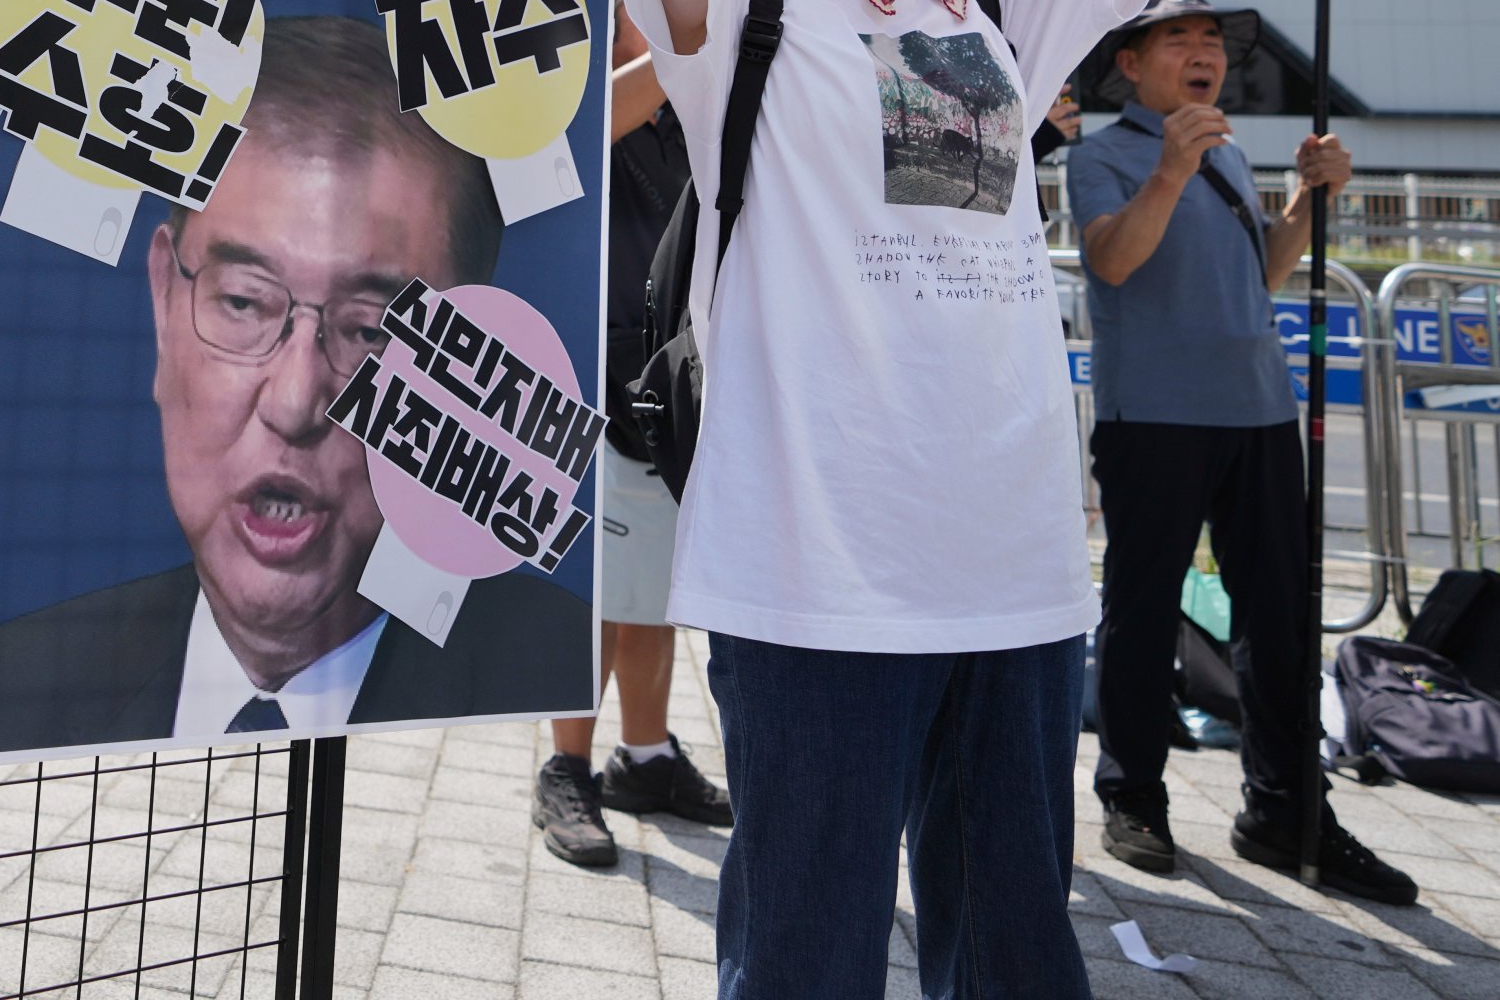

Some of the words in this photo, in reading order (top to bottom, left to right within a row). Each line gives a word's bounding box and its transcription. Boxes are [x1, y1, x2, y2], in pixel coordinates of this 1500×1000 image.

[382, 278, 606, 481] 식민지배
[1347, 315, 1440, 355] LNE
[327, 356, 590, 573] 사죄배상!
